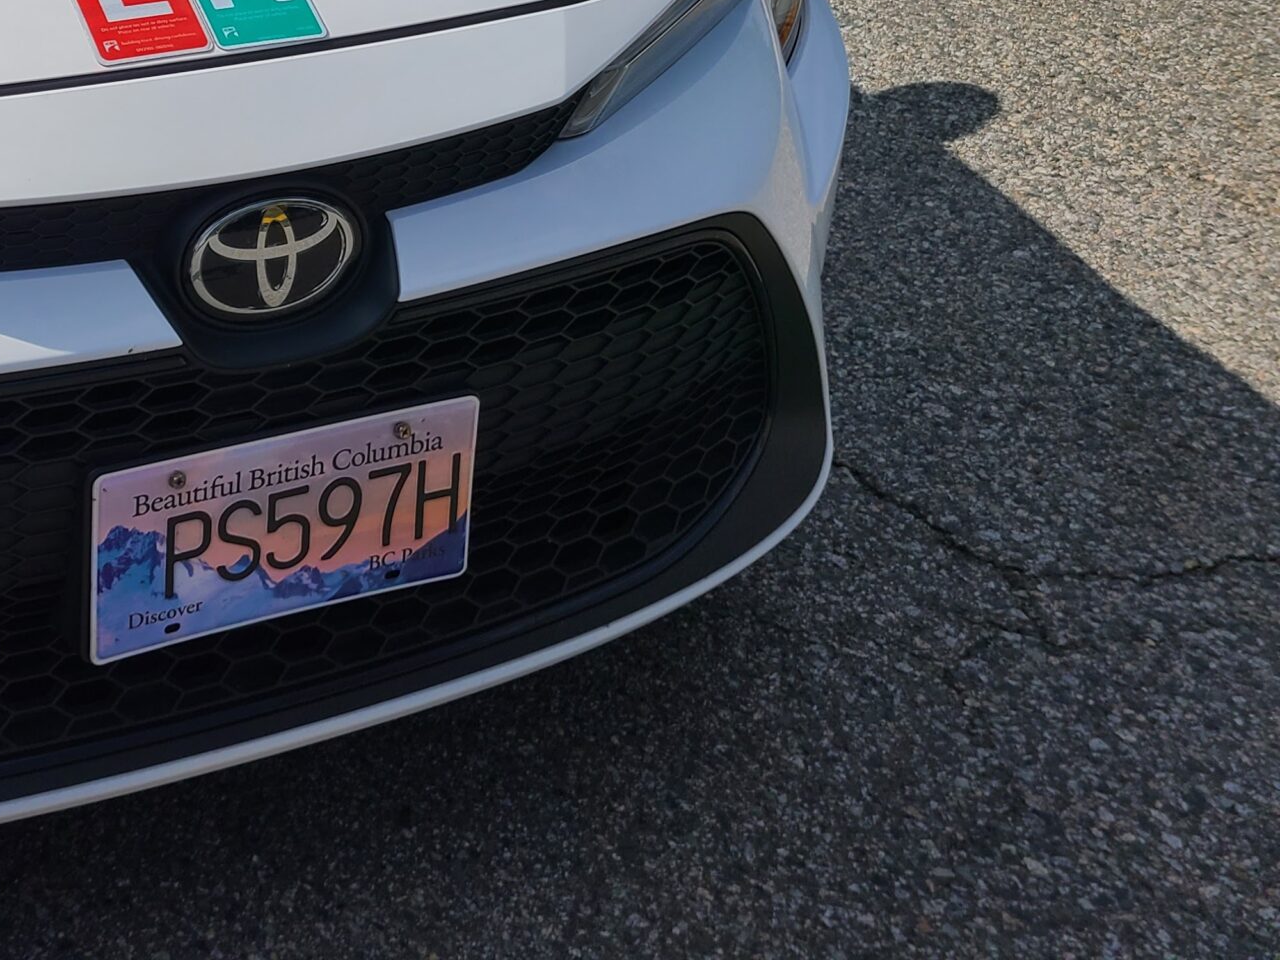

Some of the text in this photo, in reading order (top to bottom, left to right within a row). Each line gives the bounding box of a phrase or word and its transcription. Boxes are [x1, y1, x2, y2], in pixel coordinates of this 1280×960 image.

[132, 431, 444, 518] Beautiful British Columbia
[164, 452, 461, 600] PS597H
[368, 550, 396, 571] BC
[128, 599, 204, 631] Discover
